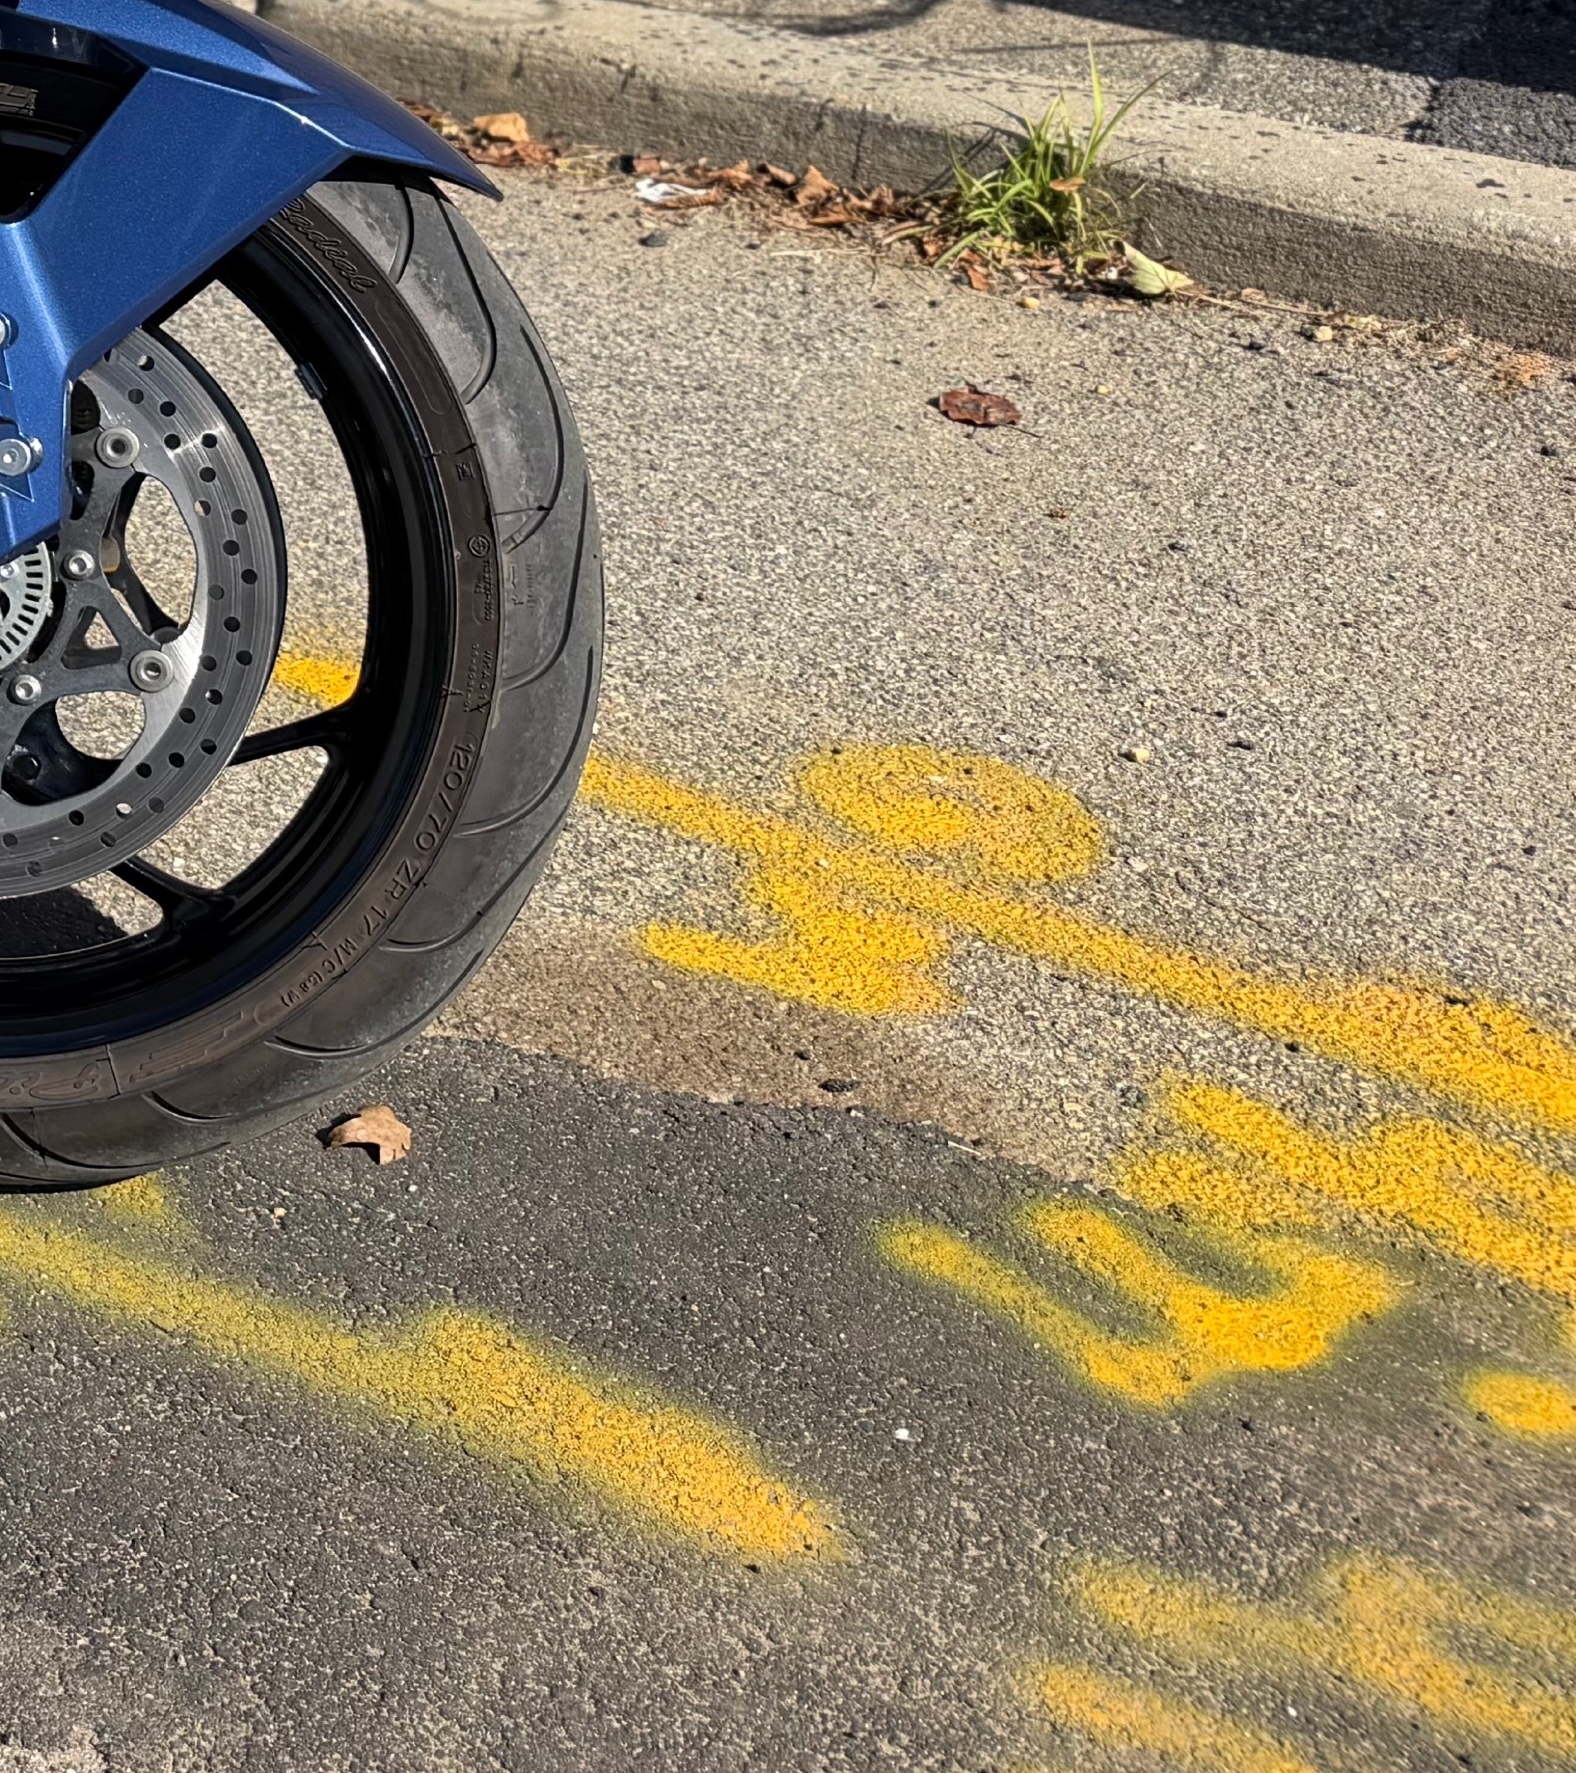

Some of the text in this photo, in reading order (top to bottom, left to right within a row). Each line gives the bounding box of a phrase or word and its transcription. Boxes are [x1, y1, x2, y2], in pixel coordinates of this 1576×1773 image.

[415, 742, 475, 853] 120/70
[382, 858, 420, 902] ZR
[355, 901, 389, 937] 17
[324, 938, 359, 976] M/C
